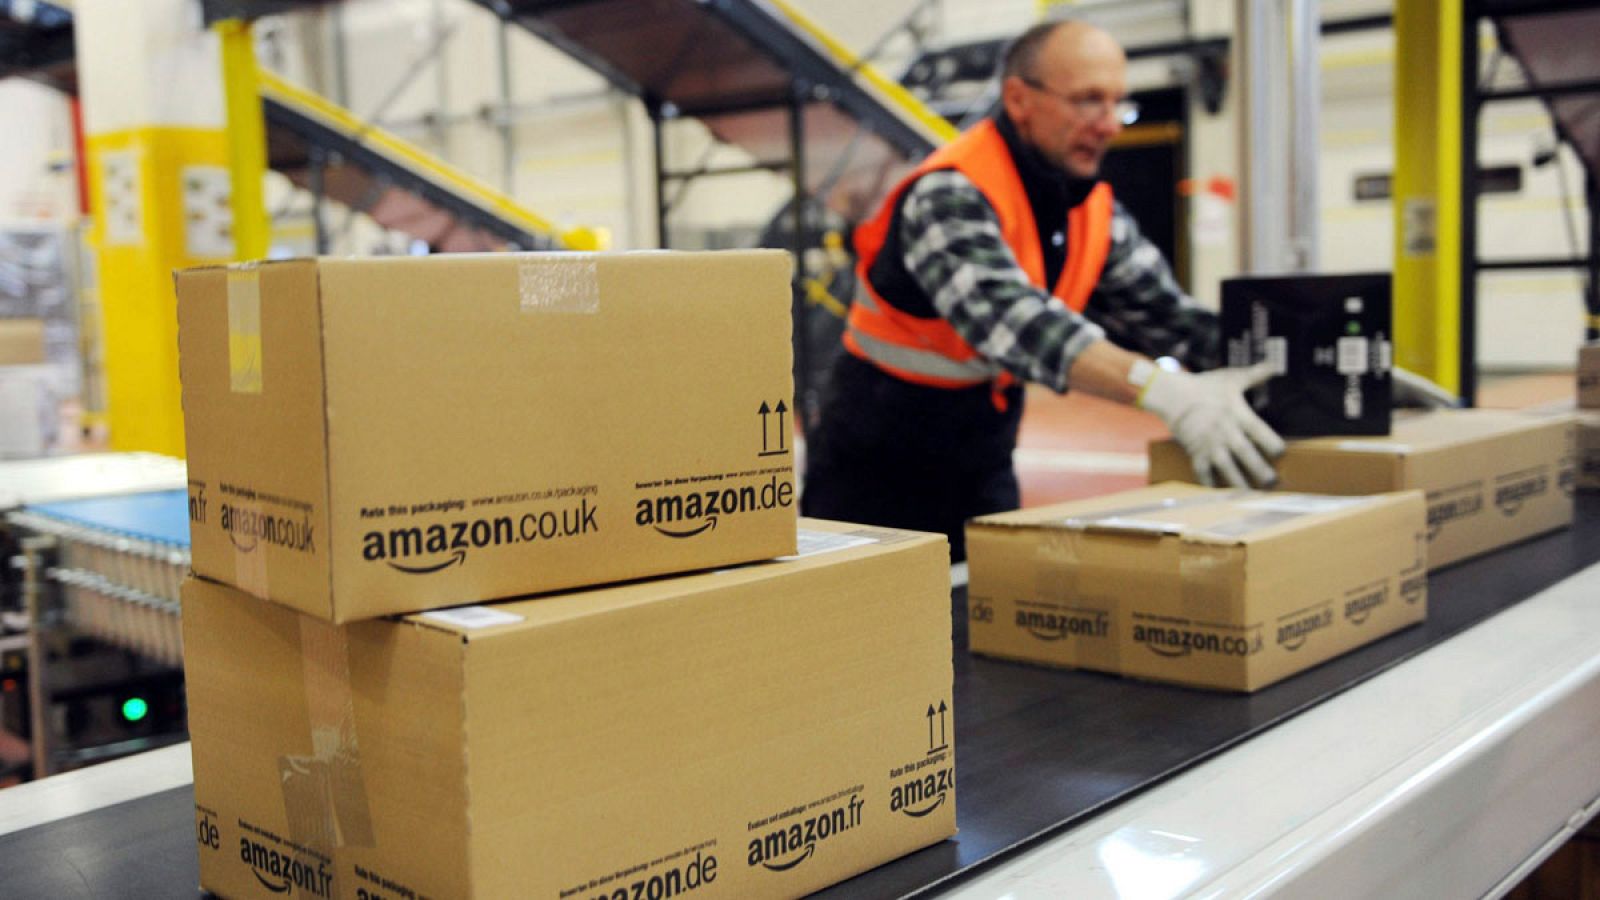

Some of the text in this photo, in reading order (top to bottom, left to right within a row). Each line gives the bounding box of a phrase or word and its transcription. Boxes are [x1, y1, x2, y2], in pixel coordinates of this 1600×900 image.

[221, 503, 316, 555] amazon.co.uk
[360, 506, 385, 520] Rate
[388, 504, 408, 516] this
[410, 499, 466, 516] packaging:
[635, 475, 793, 526] amazon.de
[363, 498, 599, 561] amazon.co.uk
[748, 795, 864, 867] amazon.fr
[240, 836, 332, 899] amazon.fr
